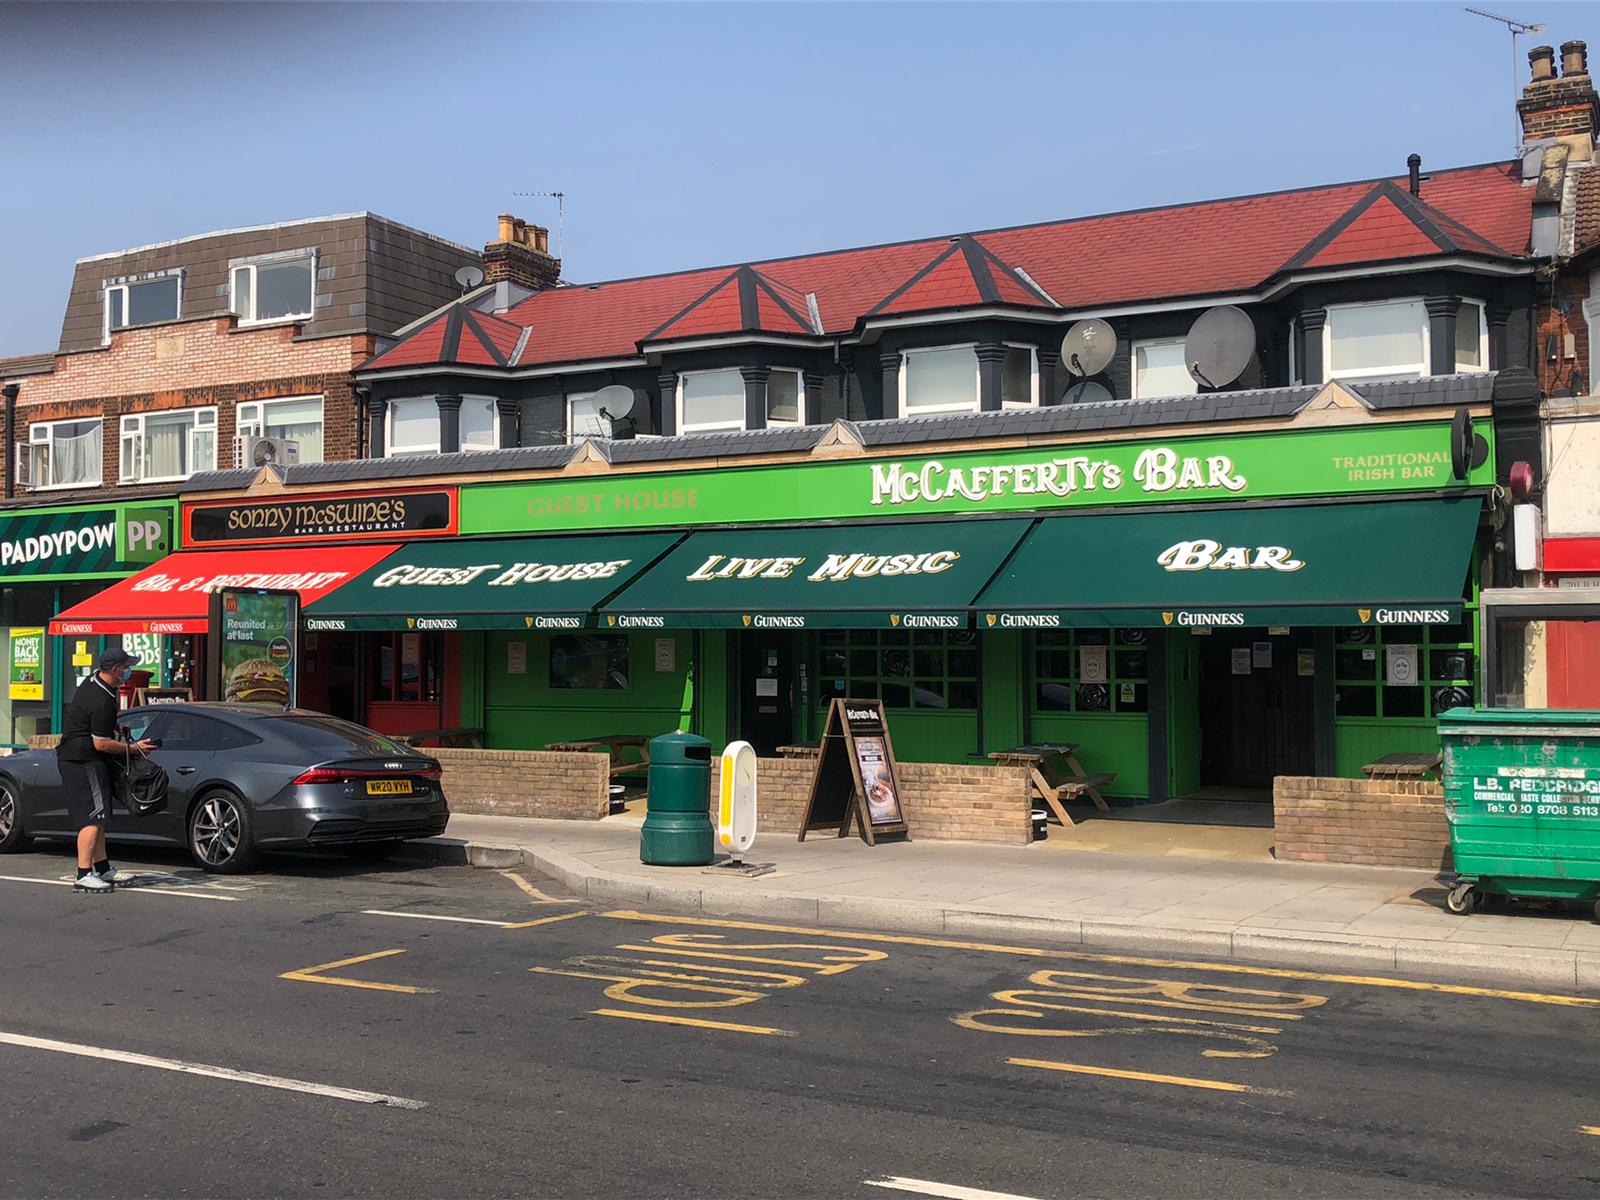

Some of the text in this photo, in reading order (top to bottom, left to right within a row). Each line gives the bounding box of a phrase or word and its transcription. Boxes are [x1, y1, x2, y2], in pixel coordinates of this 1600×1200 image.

[1333, 451, 1451, 469] TRADITIONAL
[1133, 447, 1247, 492] BAR
[1348, 465, 1435, 481] IRISH BAR
[527, 488, 699, 516] GUEST HOUSE
[329, 522, 406, 532] RESTAURANT
[1, 522, 117, 566] PADDYPOW
[1157, 539, 1306, 571] BAR
[372, 558, 633, 587] GUEST HOUSE
[686, 550, 960, 582] LIVE MUSIC
[535, 616, 580, 628] GUINNESS
[618, 615, 664, 628] GUINNESS
[754, 614, 805, 628] GUINNESS
[903, 613, 959, 628] GUINNESS
[1000, 613, 1060, 627] GUINNESS
[1177, 611, 1244, 626] GUINNESS
[1375, 608, 1450, 624] GUINNESS
[62, 622, 93, 633] GUINNESS
[150, 621, 183, 632] GUINNESS
[227, 619, 266, 629] Reunited
[307, 618, 345, 630] GUINNESS
[417, 617, 458, 629] GUINNESS
[227, 630, 254, 640] at last
[15, 637, 40, 647] MONEY
[15, 646, 39, 658] BACK
[1473, 777, 1503, 790] L.B.
[1473, 791, 1515, 801] COMMERCIAL
[1487, 803, 1504, 813] Tel:
[1537, 805, 1568, 815] 8708
[1572, 806, 1599, 816] 5113
